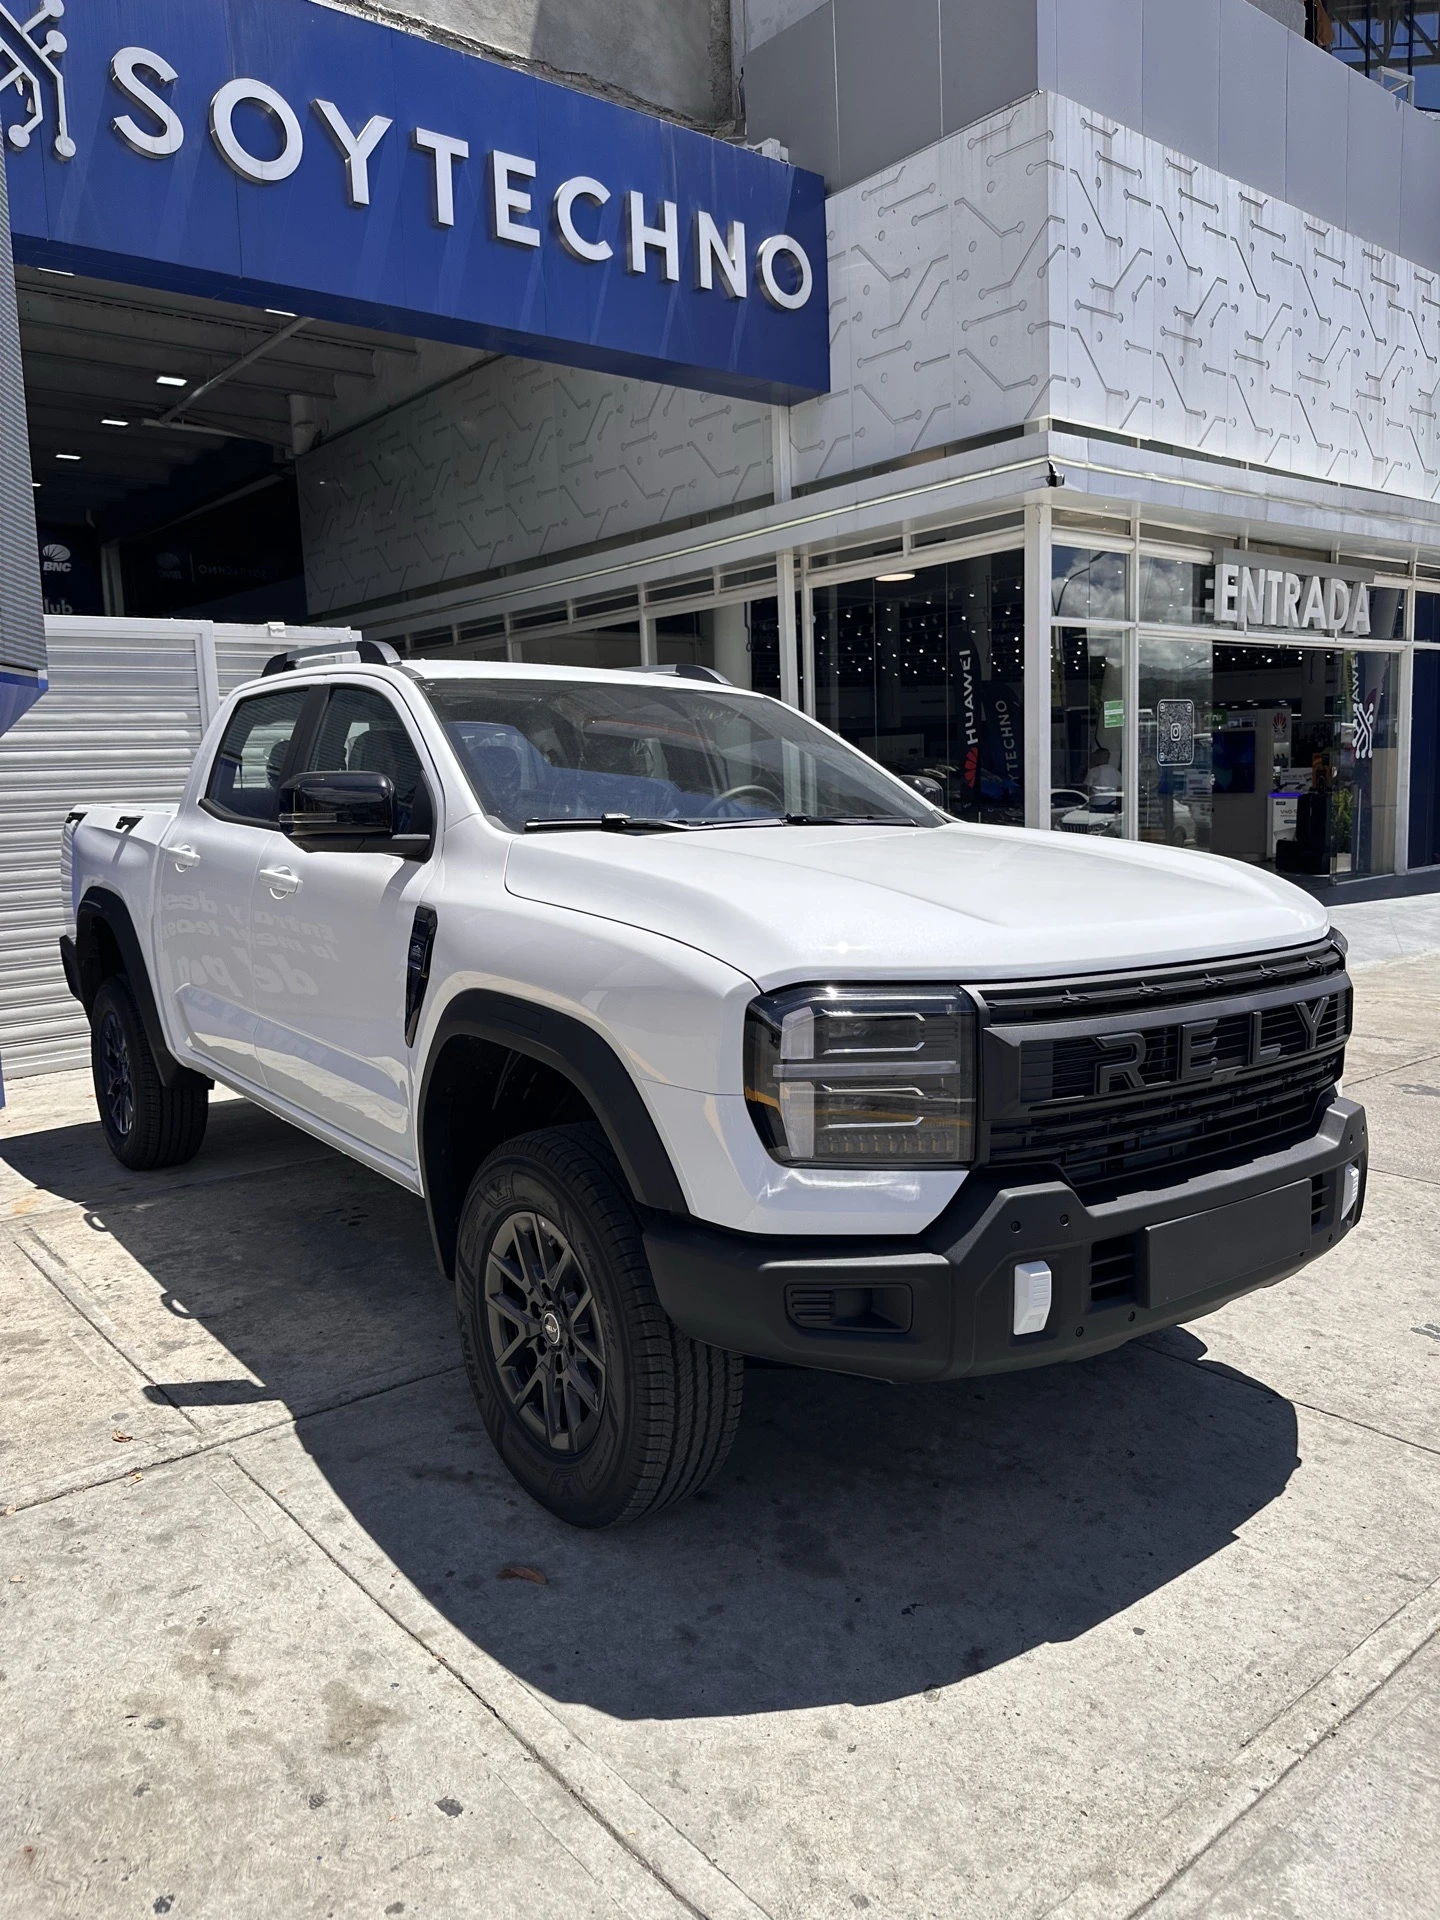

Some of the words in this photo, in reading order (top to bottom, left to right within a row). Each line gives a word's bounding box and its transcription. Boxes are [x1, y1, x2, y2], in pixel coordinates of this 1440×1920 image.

[109, 46, 813, 311] SOYTECHNO
[43, 561, 73, 573] BNC
[1214, 563, 1372, 635] ENTRADA
[959, 649, 979, 745] HUAWEI
[1096, 996, 1329, 1093] RELY
